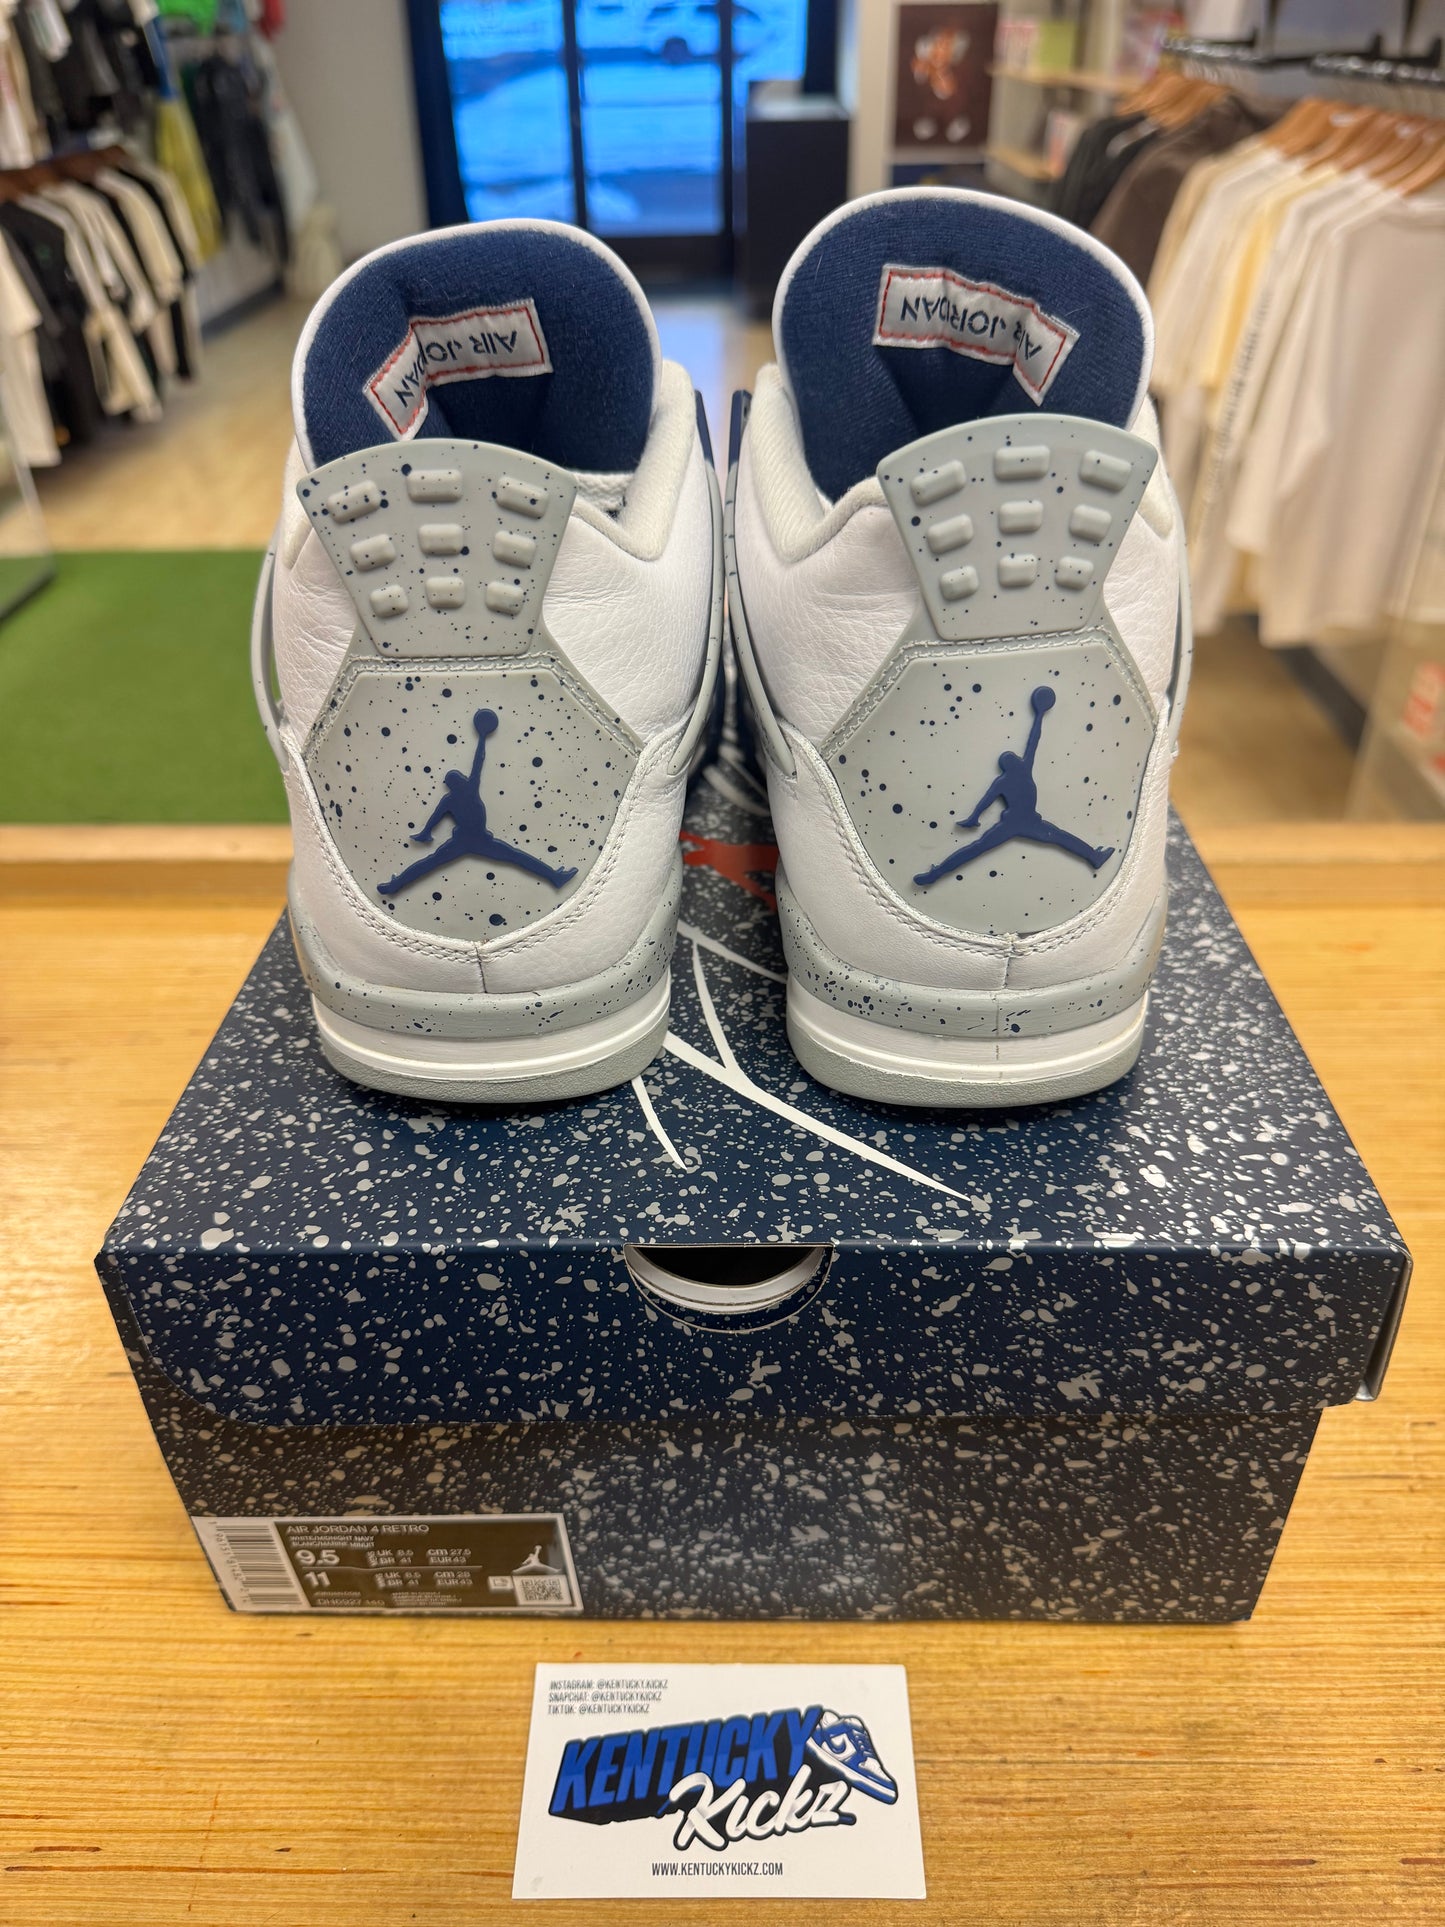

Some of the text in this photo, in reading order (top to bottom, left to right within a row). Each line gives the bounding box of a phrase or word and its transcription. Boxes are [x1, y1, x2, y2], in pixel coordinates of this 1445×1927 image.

[900, 296, 1006, 338] JORDAN
[468, 330, 517, 355] AIR
[287, 1524, 430, 1534] AIR JORDAN 4 RETRO
[294, 1549, 340, 1566] 9.5
[377, 1549, 394, 1557] UK
[427, 1548, 449, 1556] cm
[304, 1571, 331, 1587] 11
[384, 1571, 401, 1579] UK
[433, 1571, 456, 1579] cm
[549, 1679, 595, 1690] INSTAGRAM:
[548, 1690, 663, 1702] SNAPCHAT: @KENTUCKYKICKZ
[547, 1703, 651, 1714] TIKTOK: @KENTUCKYKICKZ
[549, 1706, 823, 1816] KENTUCKY
[669, 1763, 850, 1849] Kickz
[651, 1861, 784, 1876] WWW.KENTUCKYKICKZ.COM
